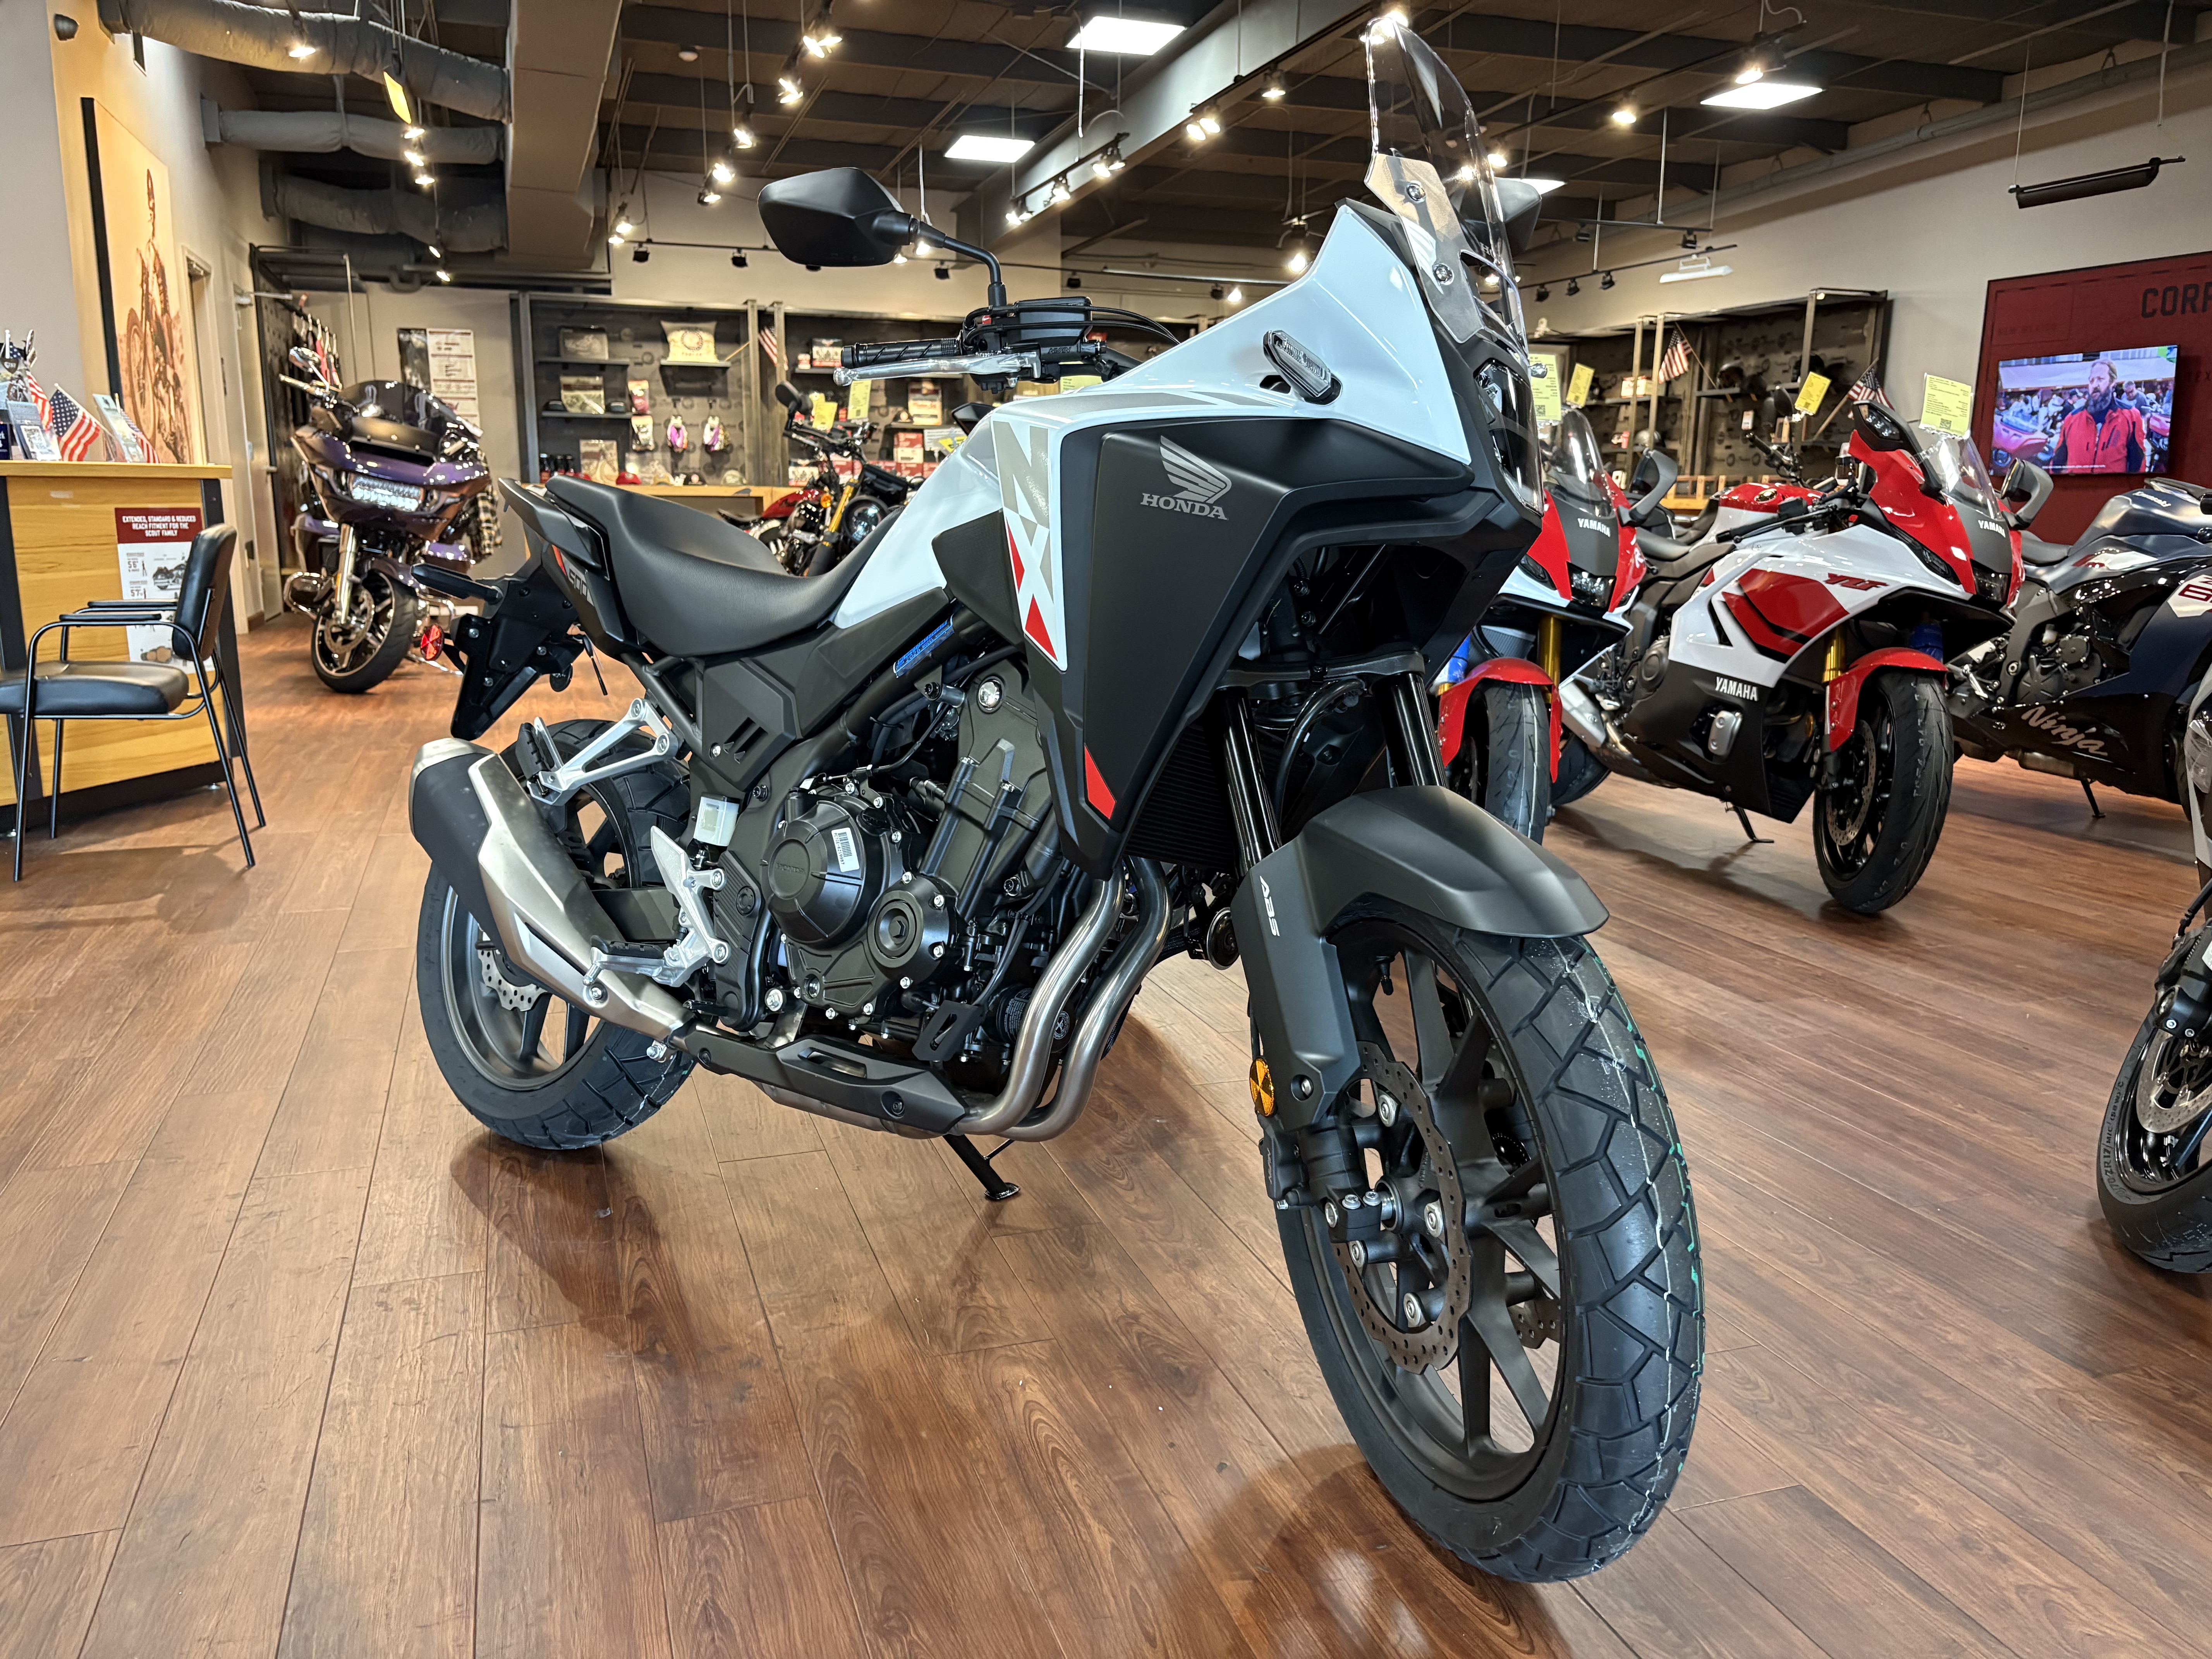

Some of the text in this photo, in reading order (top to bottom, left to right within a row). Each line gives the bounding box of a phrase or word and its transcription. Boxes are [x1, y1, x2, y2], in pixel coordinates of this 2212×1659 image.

[1140, 493, 1228, 520] HONDA
[1577, 518, 1611, 538] YAMAHA
[1978, 520, 2006, 538] YAMAHA
[1715, 676, 1759, 702] YAMAHA
[2021, 705, 2108, 756] Ninja
[1259, 875, 1280, 937] ABS
